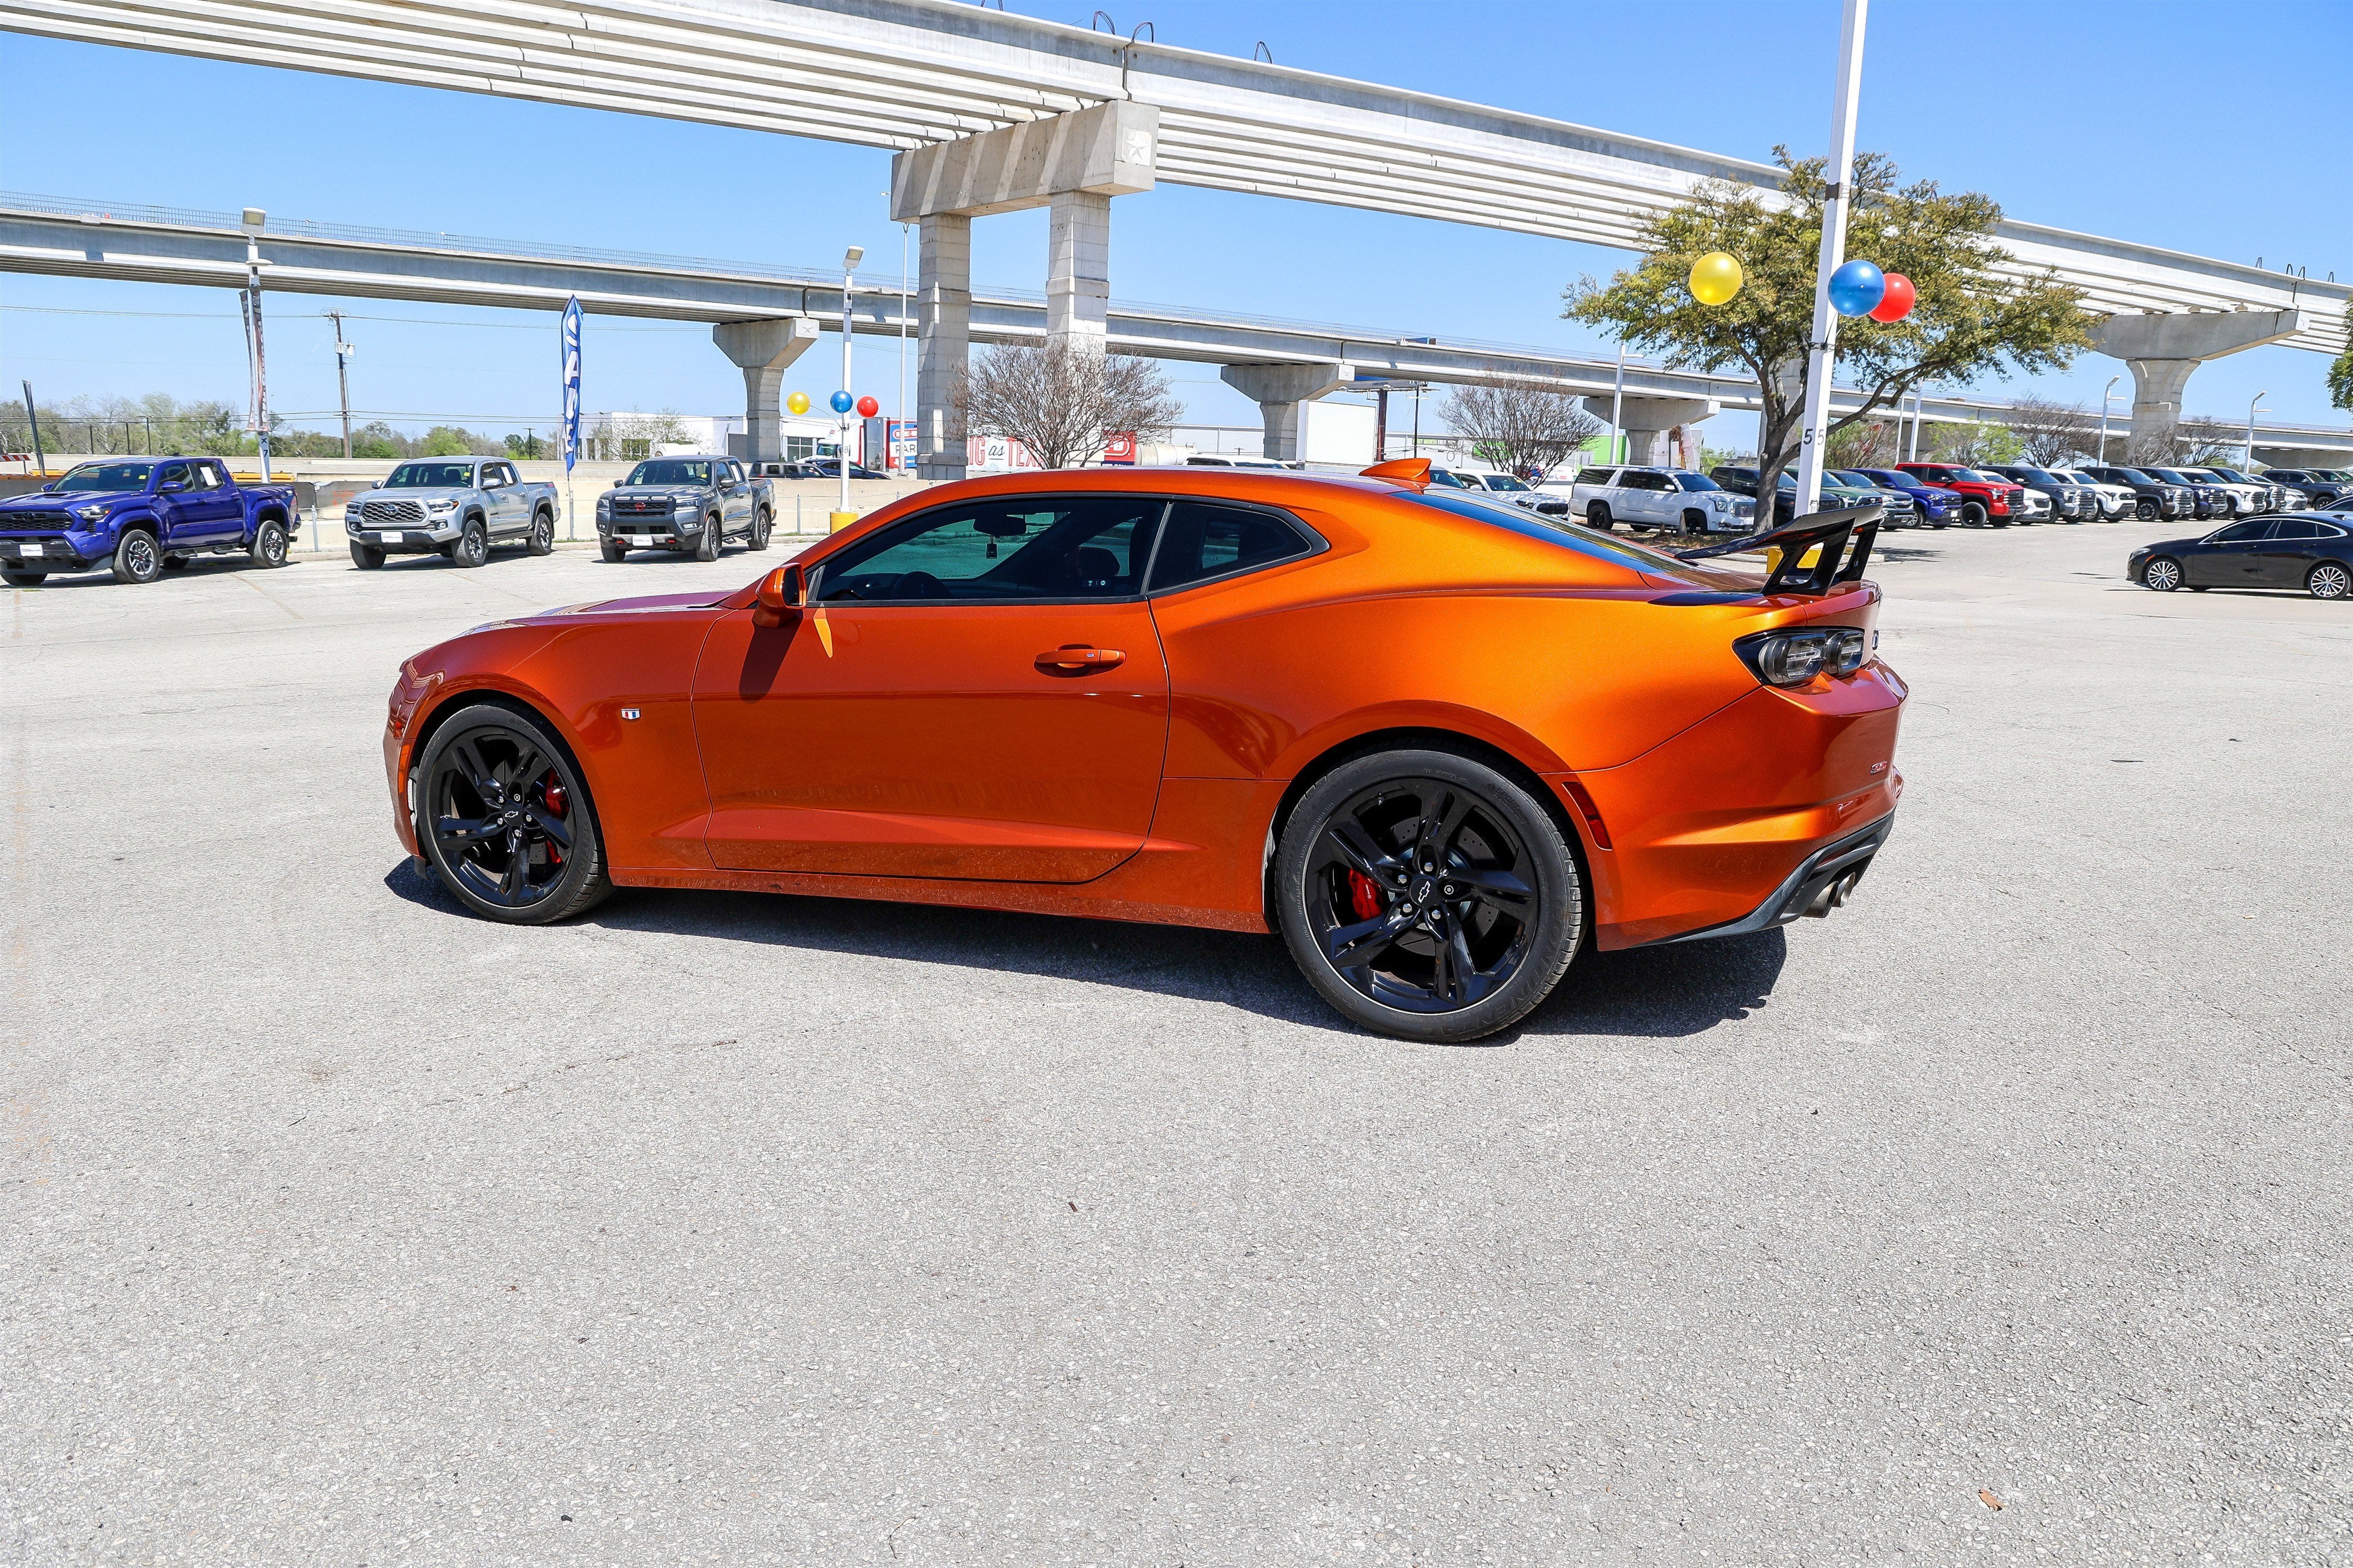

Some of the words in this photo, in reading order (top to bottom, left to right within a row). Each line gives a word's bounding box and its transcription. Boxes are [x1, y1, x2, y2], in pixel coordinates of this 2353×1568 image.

[1803, 428, 1814, 445] 5
[1818, 428, 1824, 446] 5
[263, 449, 268, 457] 7
[844, 446, 848, 454] 8
[966, 436, 985, 466] IG
[988, 445, 1005, 456] as
